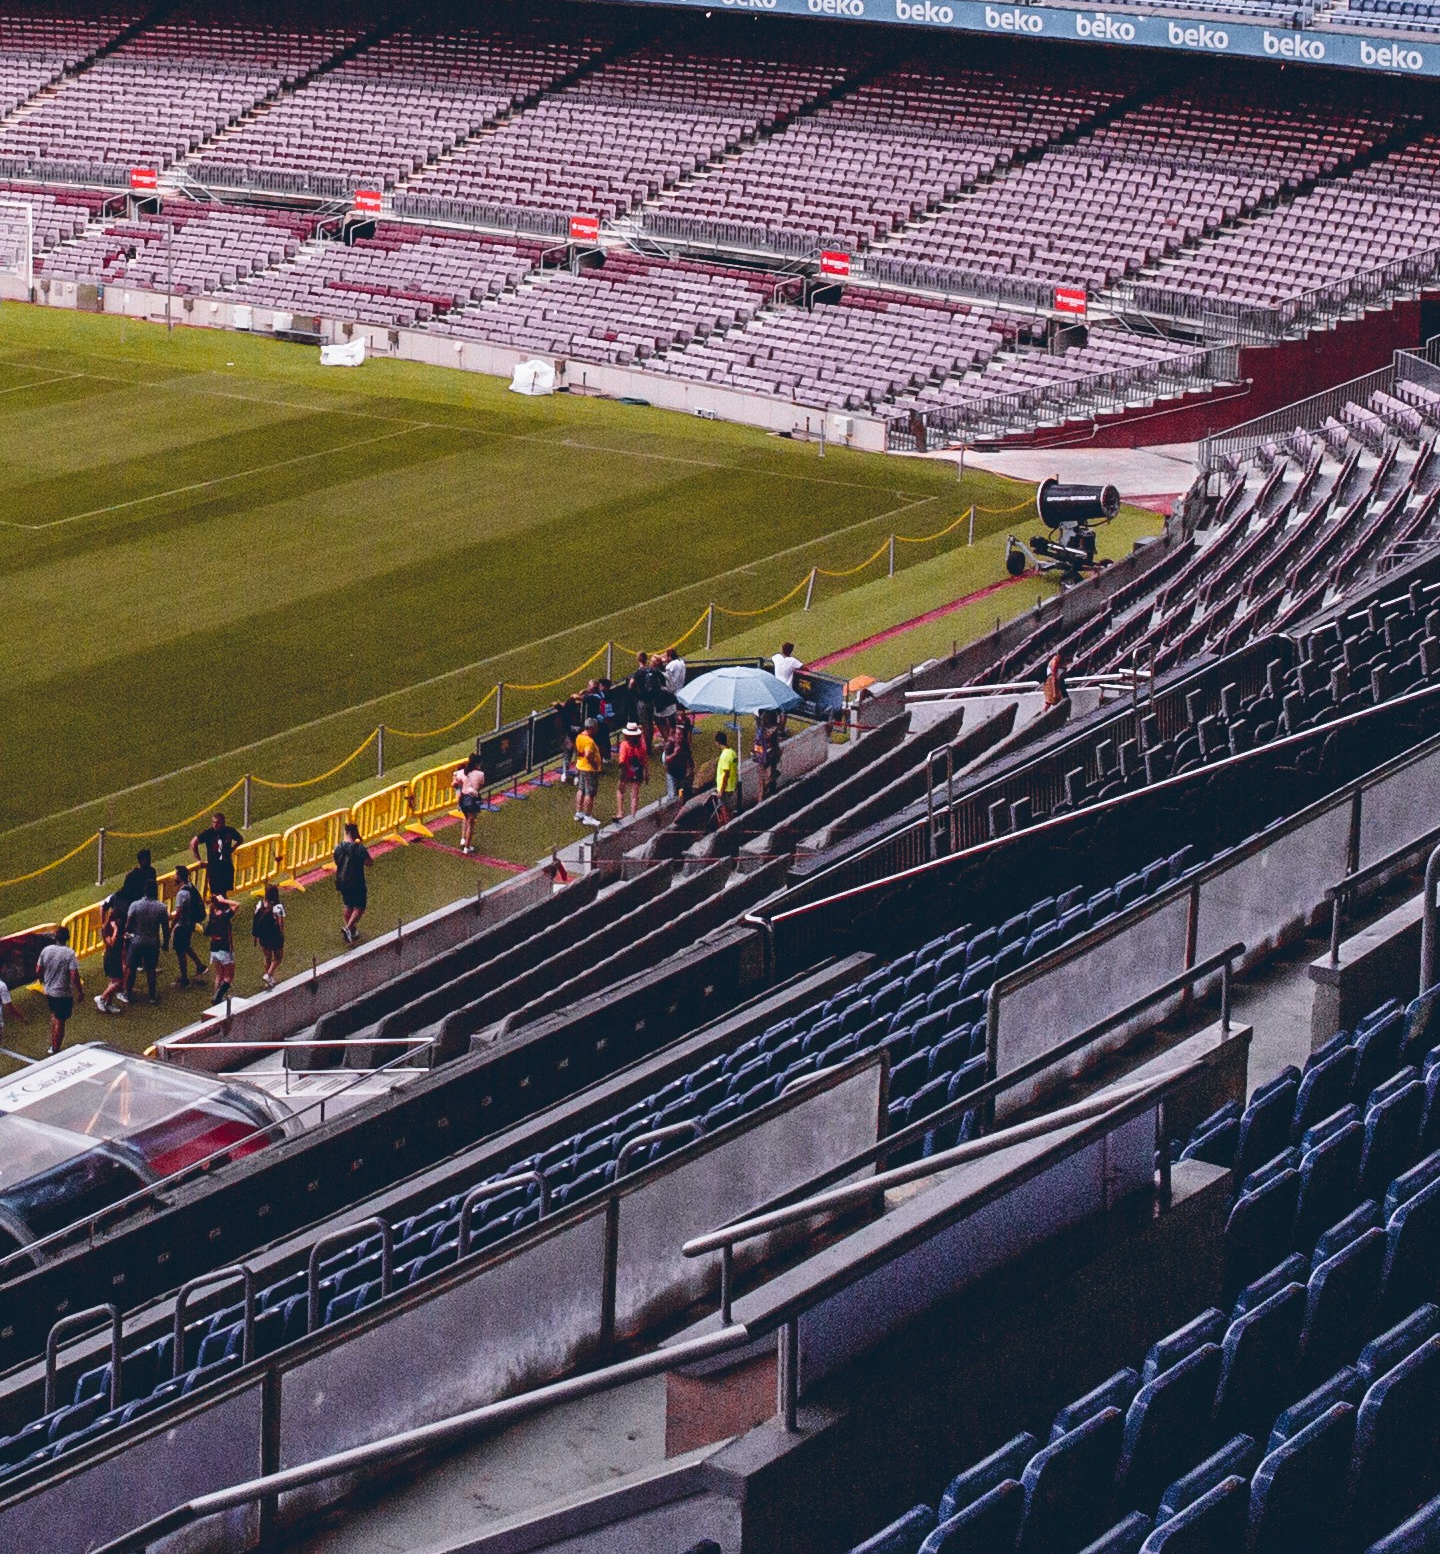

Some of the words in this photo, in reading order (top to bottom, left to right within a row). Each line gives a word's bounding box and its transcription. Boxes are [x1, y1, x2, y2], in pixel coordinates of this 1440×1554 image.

[897, 0, 953, 23] beko
[986, 7, 1042, 32] beko
[1077, 16, 1135, 40] beko
[1169, 22, 1228, 48] beko
[1264, 31, 1324, 59] beko
[1361, 41, 1422, 70] beko
